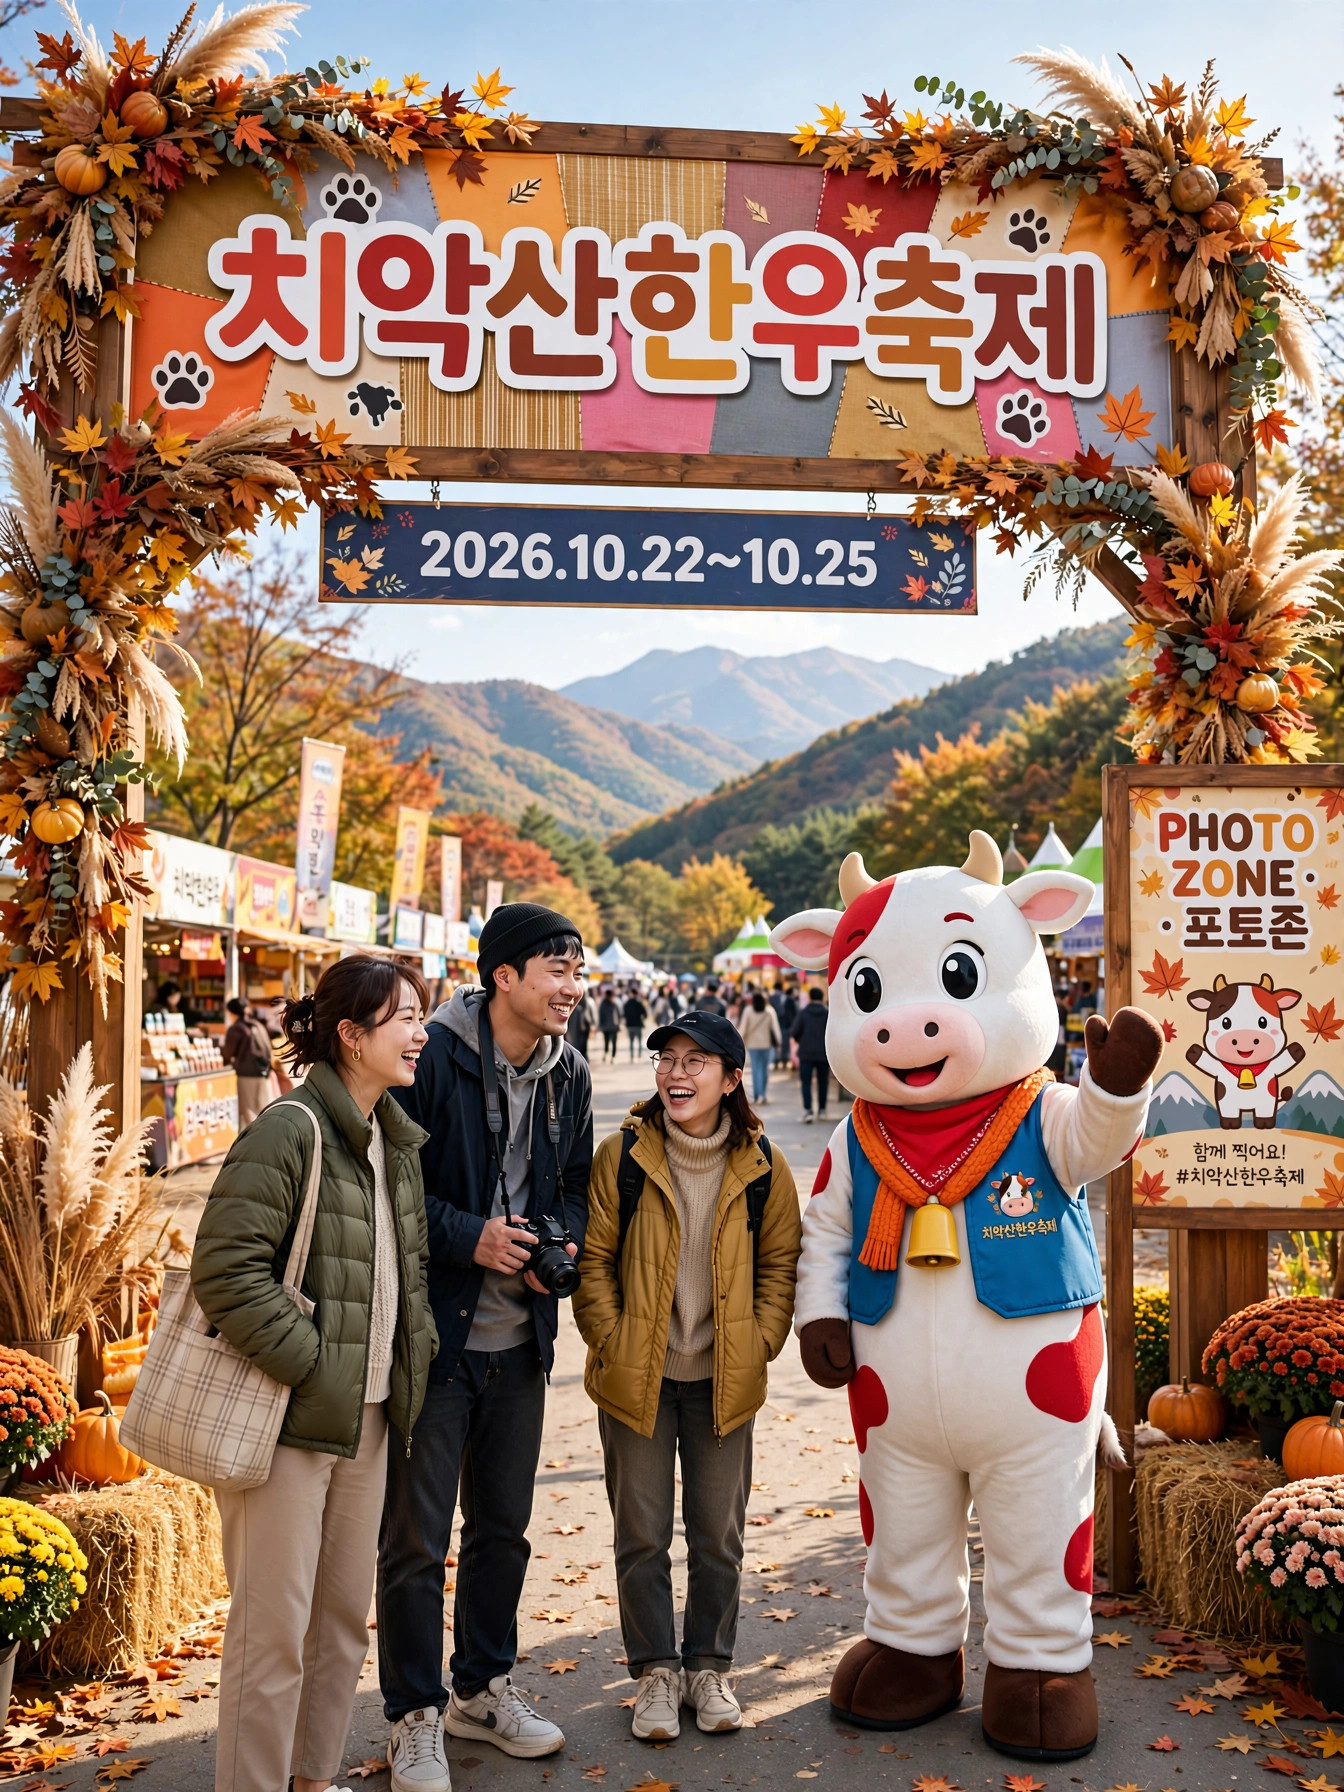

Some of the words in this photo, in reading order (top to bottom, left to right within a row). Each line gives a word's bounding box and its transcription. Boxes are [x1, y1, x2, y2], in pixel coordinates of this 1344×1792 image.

[218, 227, 1106, 394] 치악산한우축제
[419, 530, 879, 588] 2026.10.22~10.25
[1159, 812, 1315, 853] PHOTO
[1172, 859, 1296, 898] ZONE
[1183, 905, 1309, 950] 포토존
[1193, 1142, 1226, 1163] 함께
[1232, 1143, 1286, 1162] 찍어요!
[1176, 1166, 1304, 1187] #치악산한우축제
